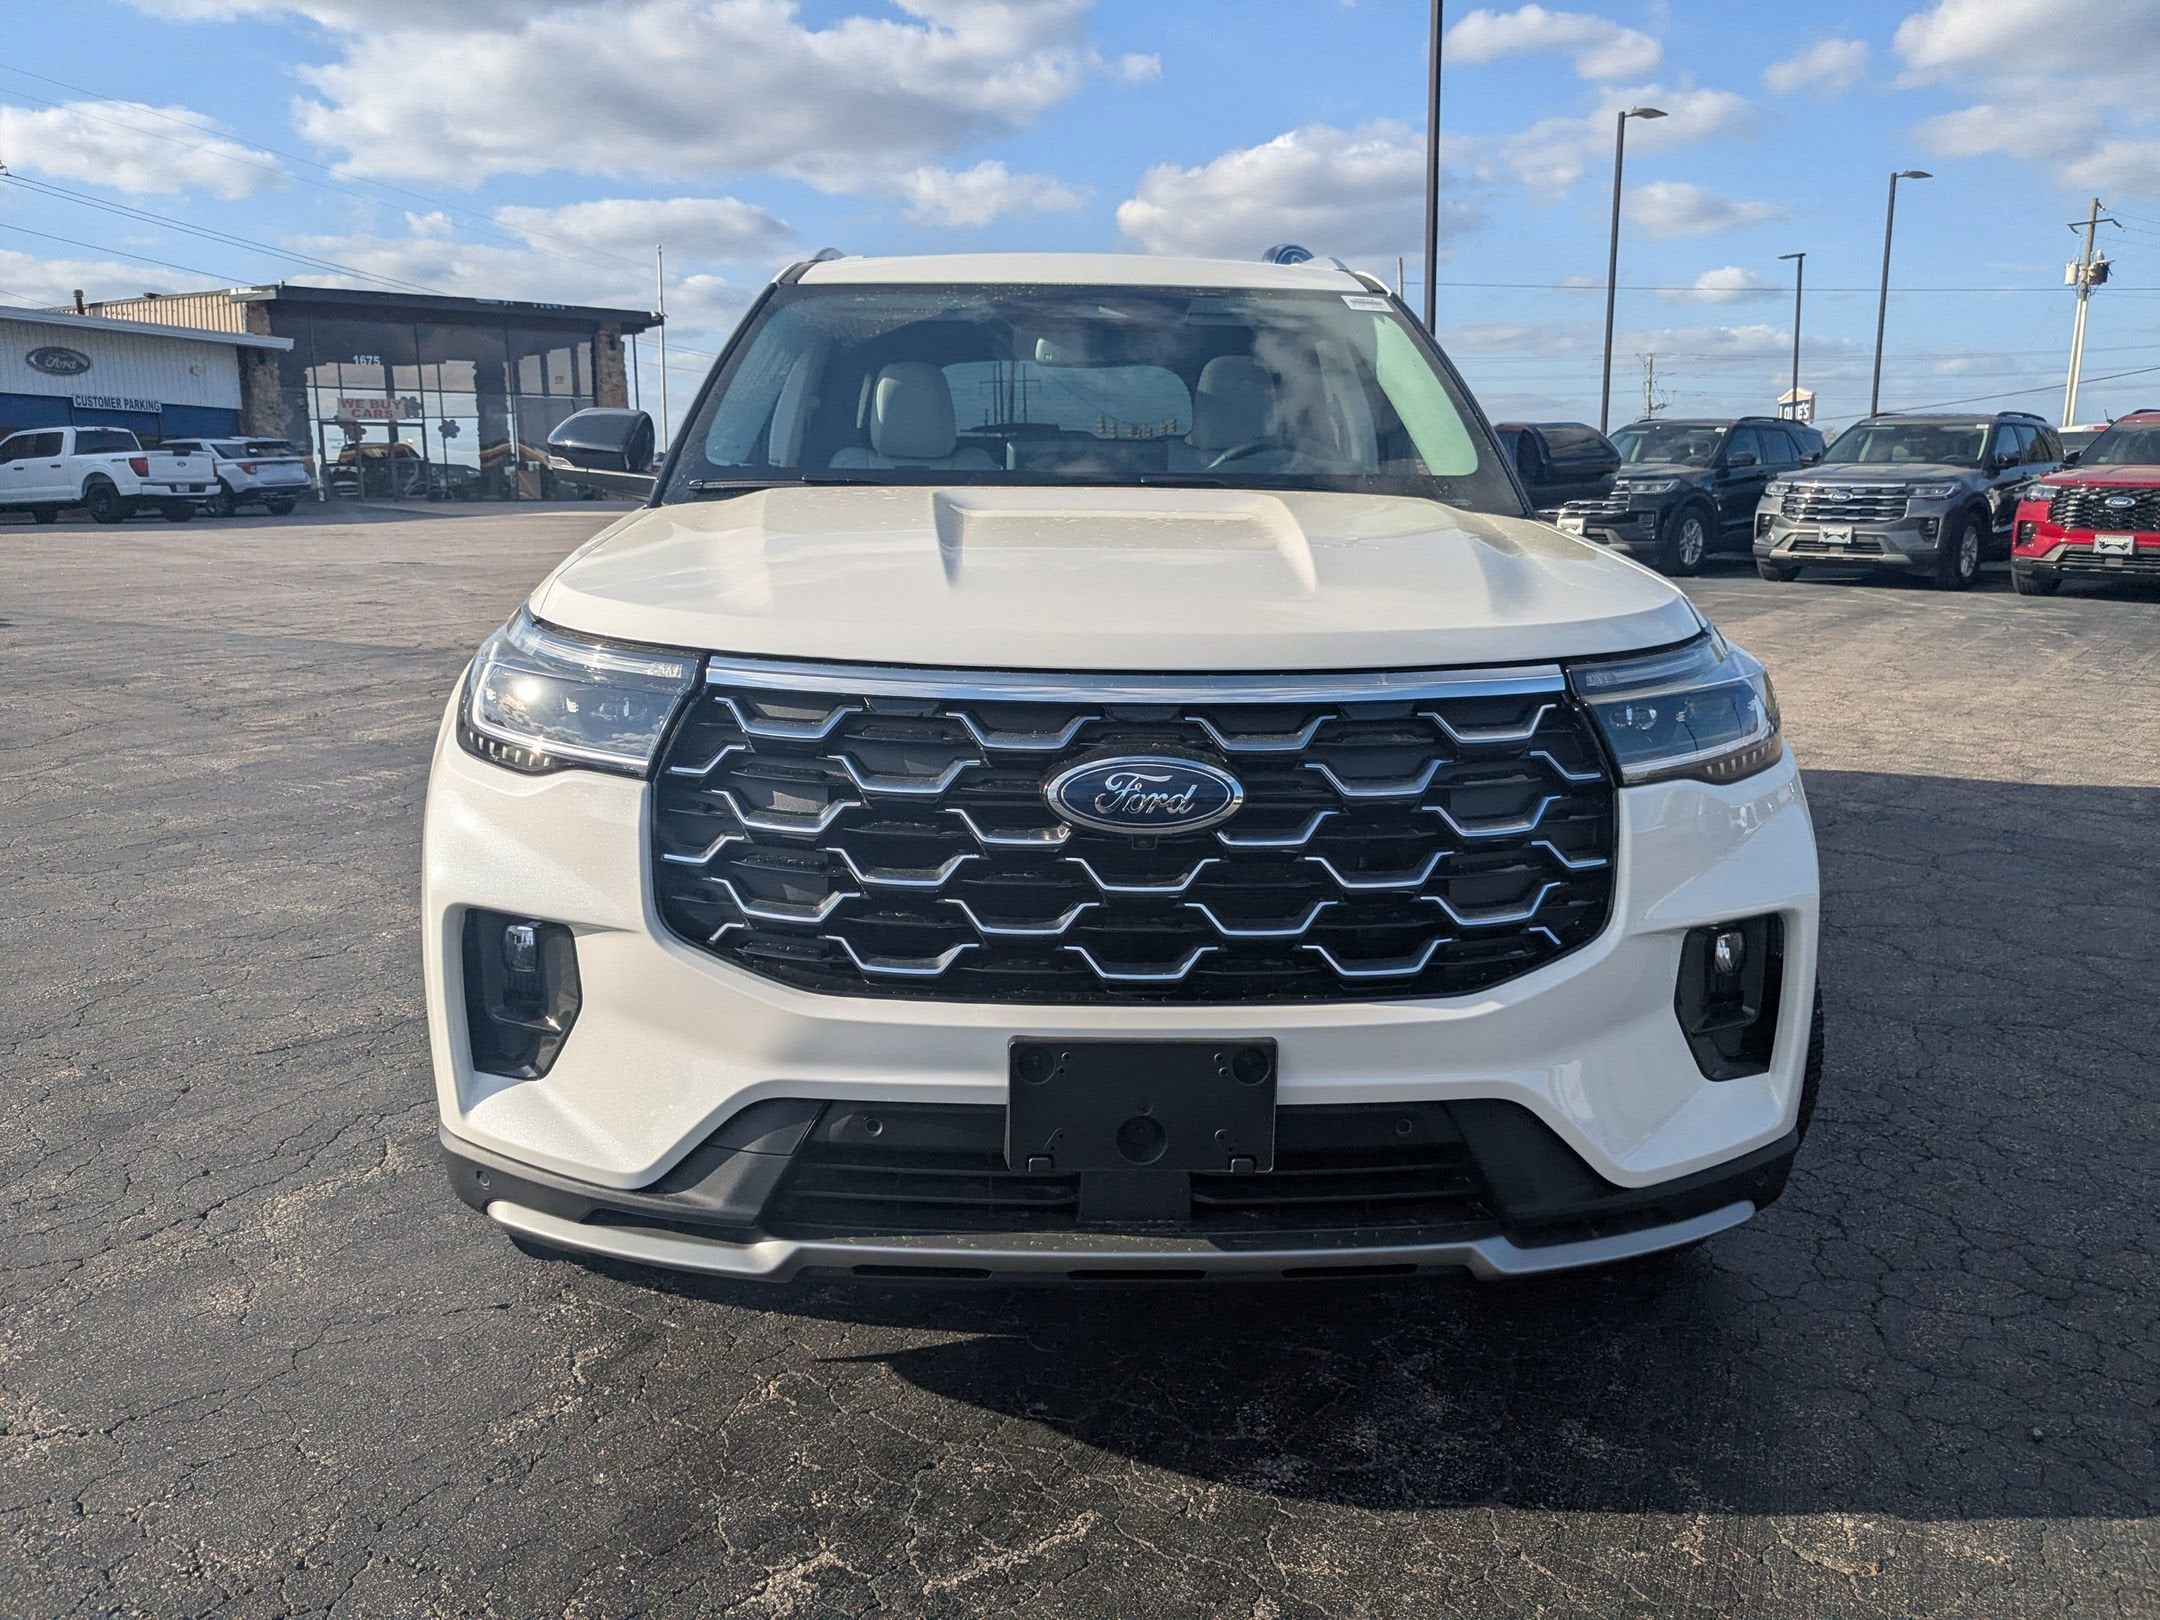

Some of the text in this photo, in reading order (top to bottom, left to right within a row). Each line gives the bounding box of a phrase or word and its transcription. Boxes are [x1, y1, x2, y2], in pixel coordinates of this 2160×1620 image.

[45, 354, 77, 369] Ford
[353, 355, 380, 366] 1675
[75, 396, 160, 412] CUSTOMER PARKING
[341, 399, 402, 410] WE BUY
[351, 408, 393, 418] CARS
[1094, 772, 1199, 815] Ford
